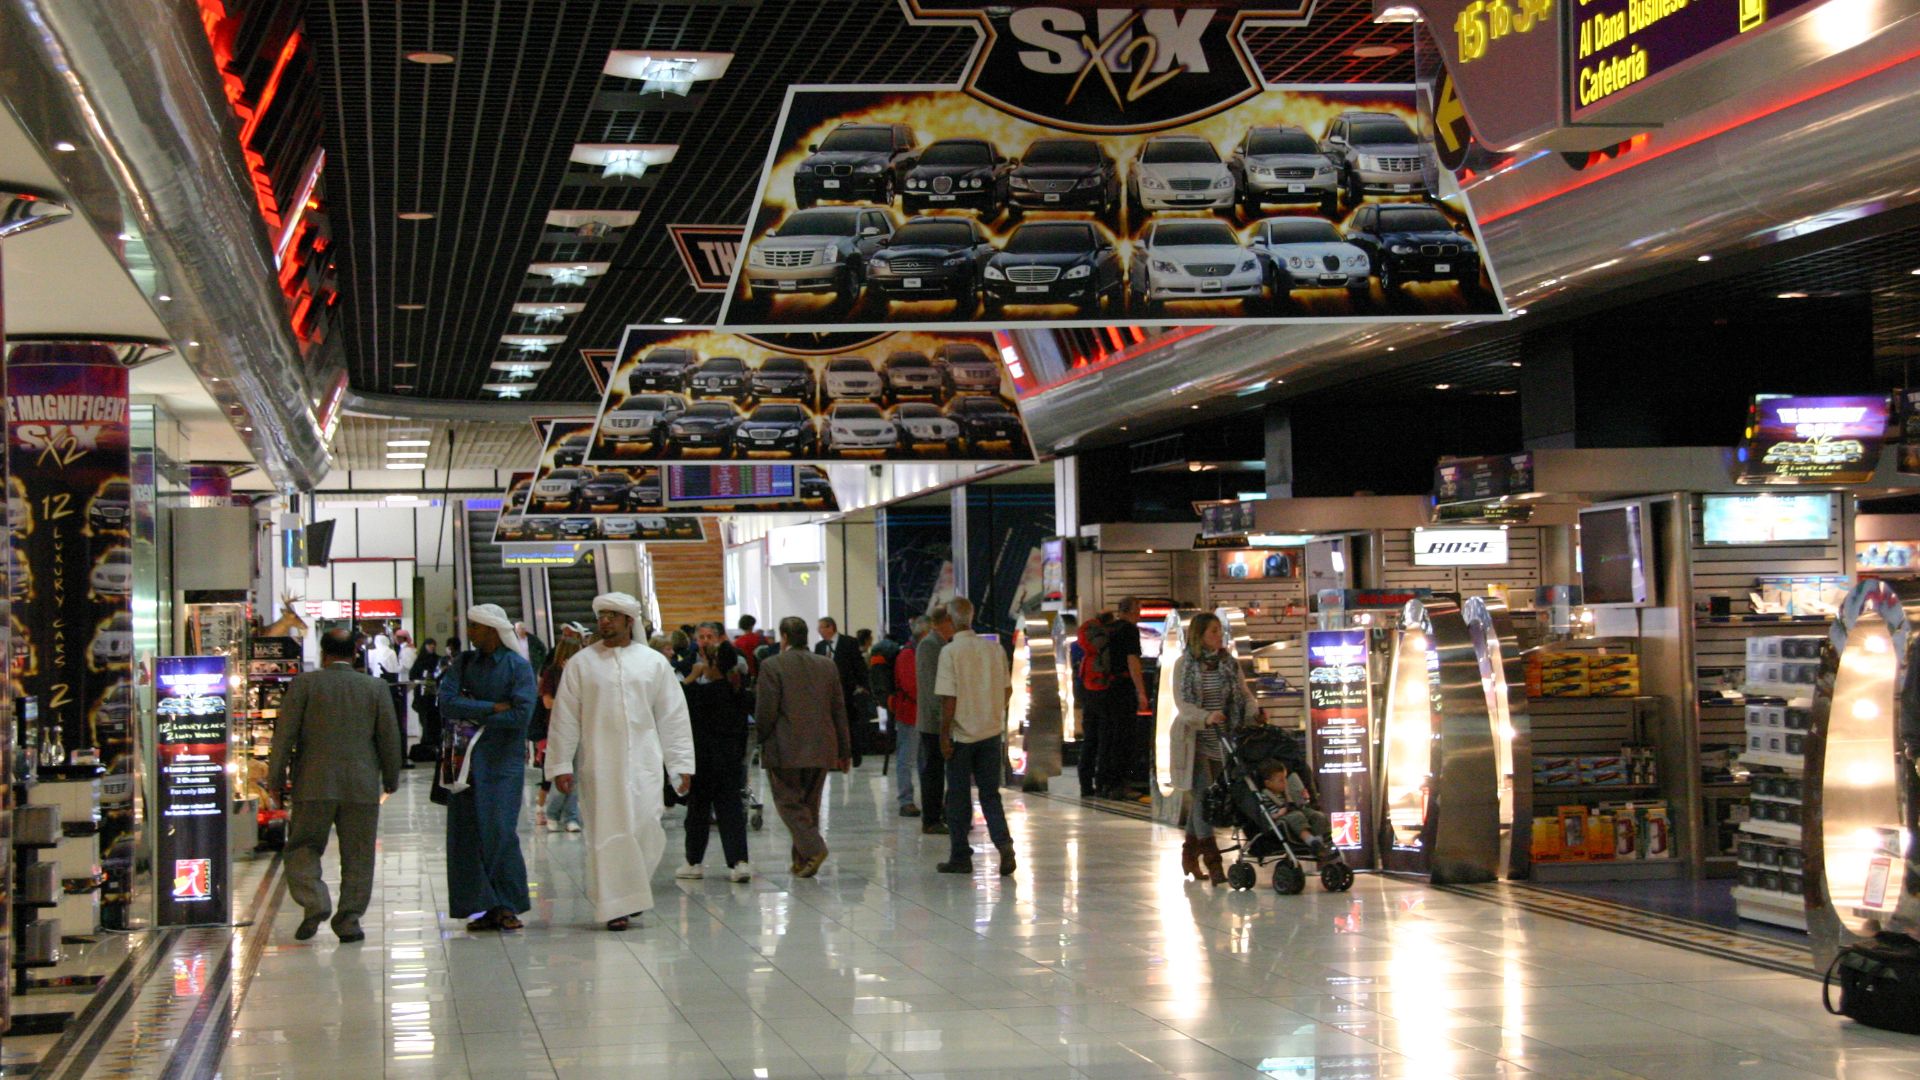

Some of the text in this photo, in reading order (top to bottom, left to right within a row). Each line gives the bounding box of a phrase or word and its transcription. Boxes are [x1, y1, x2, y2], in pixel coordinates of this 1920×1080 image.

[1009, 7, 1218, 75] SIX
[1453, 0, 1487, 63] 15
[1579, 19, 1594, 60] Al
[1594, 11, 1628, 52] Dana
[1579, 44, 1648, 107] Cafeteria
[697, 242, 742, 277] TH
[16, 394, 127, 422] MAGNIFICENT
[17, 424, 102, 452] SIX
[42, 492, 75, 520] 12
[1427, 541, 1496, 554] BOSE
[49, 683, 74, 708] 2
[159, 722, 172, 734] 12
[166, 732, 174, 741] 2
